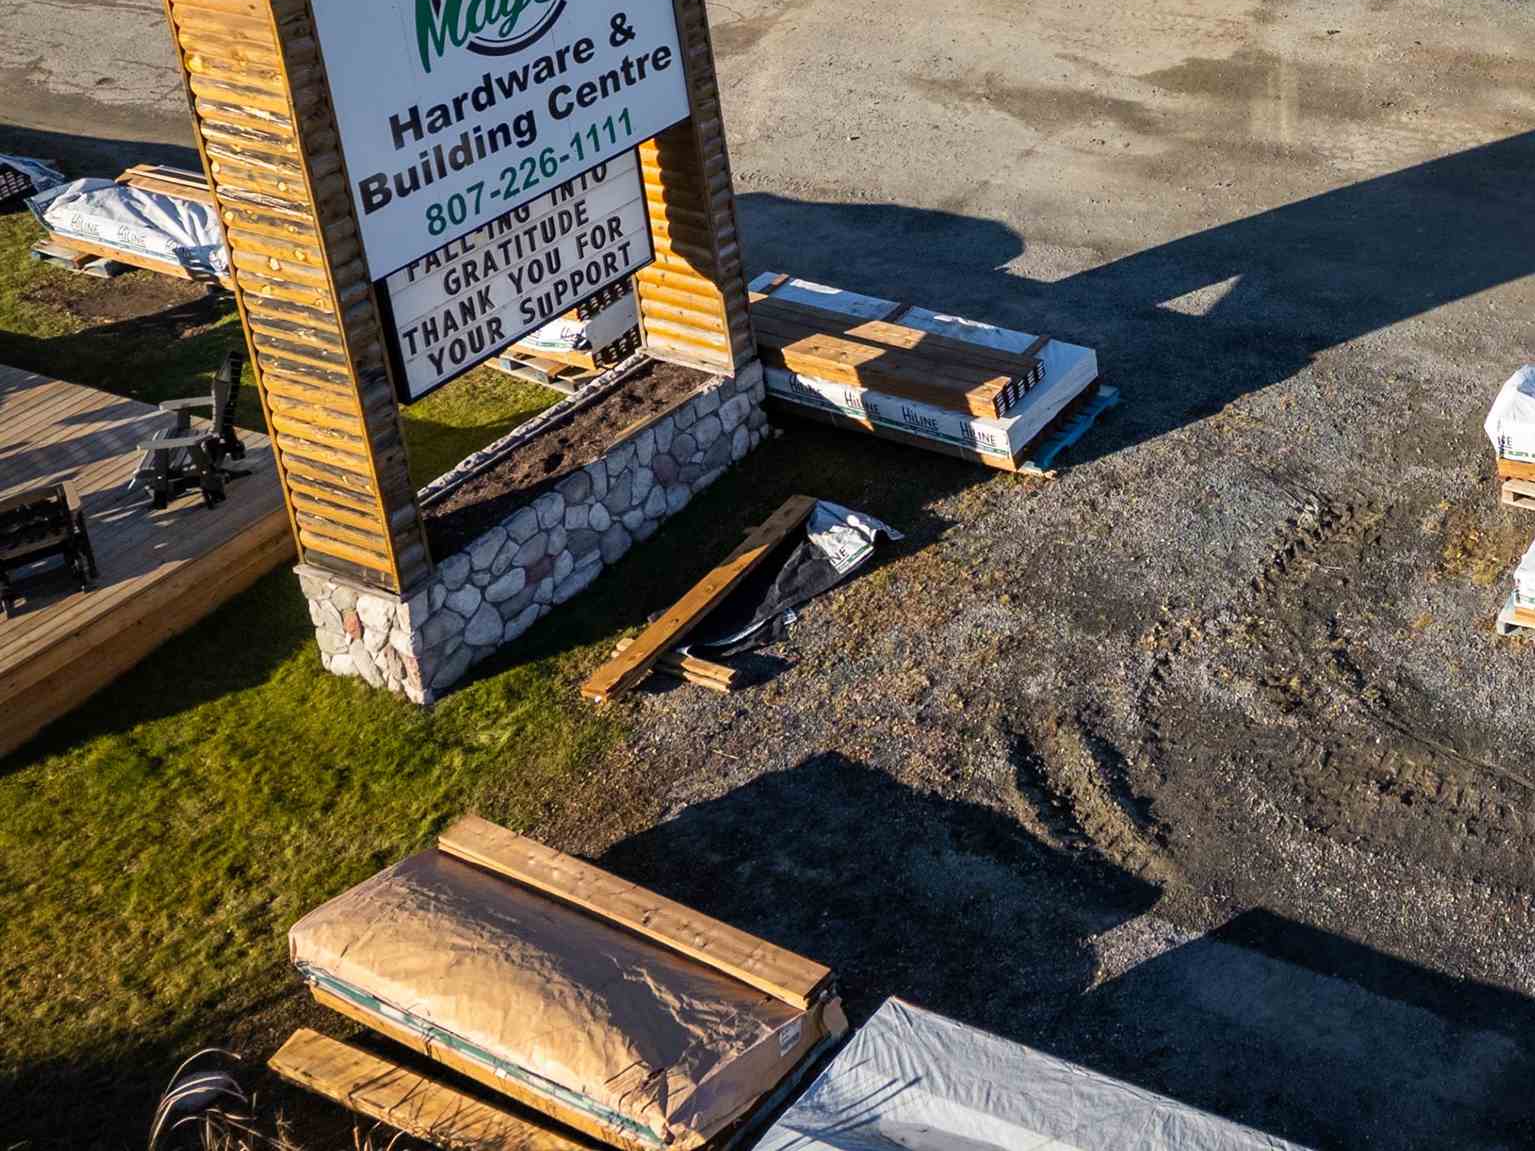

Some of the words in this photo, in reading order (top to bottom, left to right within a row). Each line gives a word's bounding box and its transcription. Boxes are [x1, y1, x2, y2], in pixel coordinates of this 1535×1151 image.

[358, 110, 537, 215] Building
[548, 45, 672, 120] Centre
[388, 37, 595, 151] Hardware
[609, 12, 636, 47] &
[425, 107, 634, 236] 807-226-1111
[403, 285, 496, 356] THANK
[508, 248, 562, 295] YOU
[575, 216, 624, 259] FOR
[444, 199, 590, 296] GRATITUDE
[427, 317, 506, 377] YOUR
